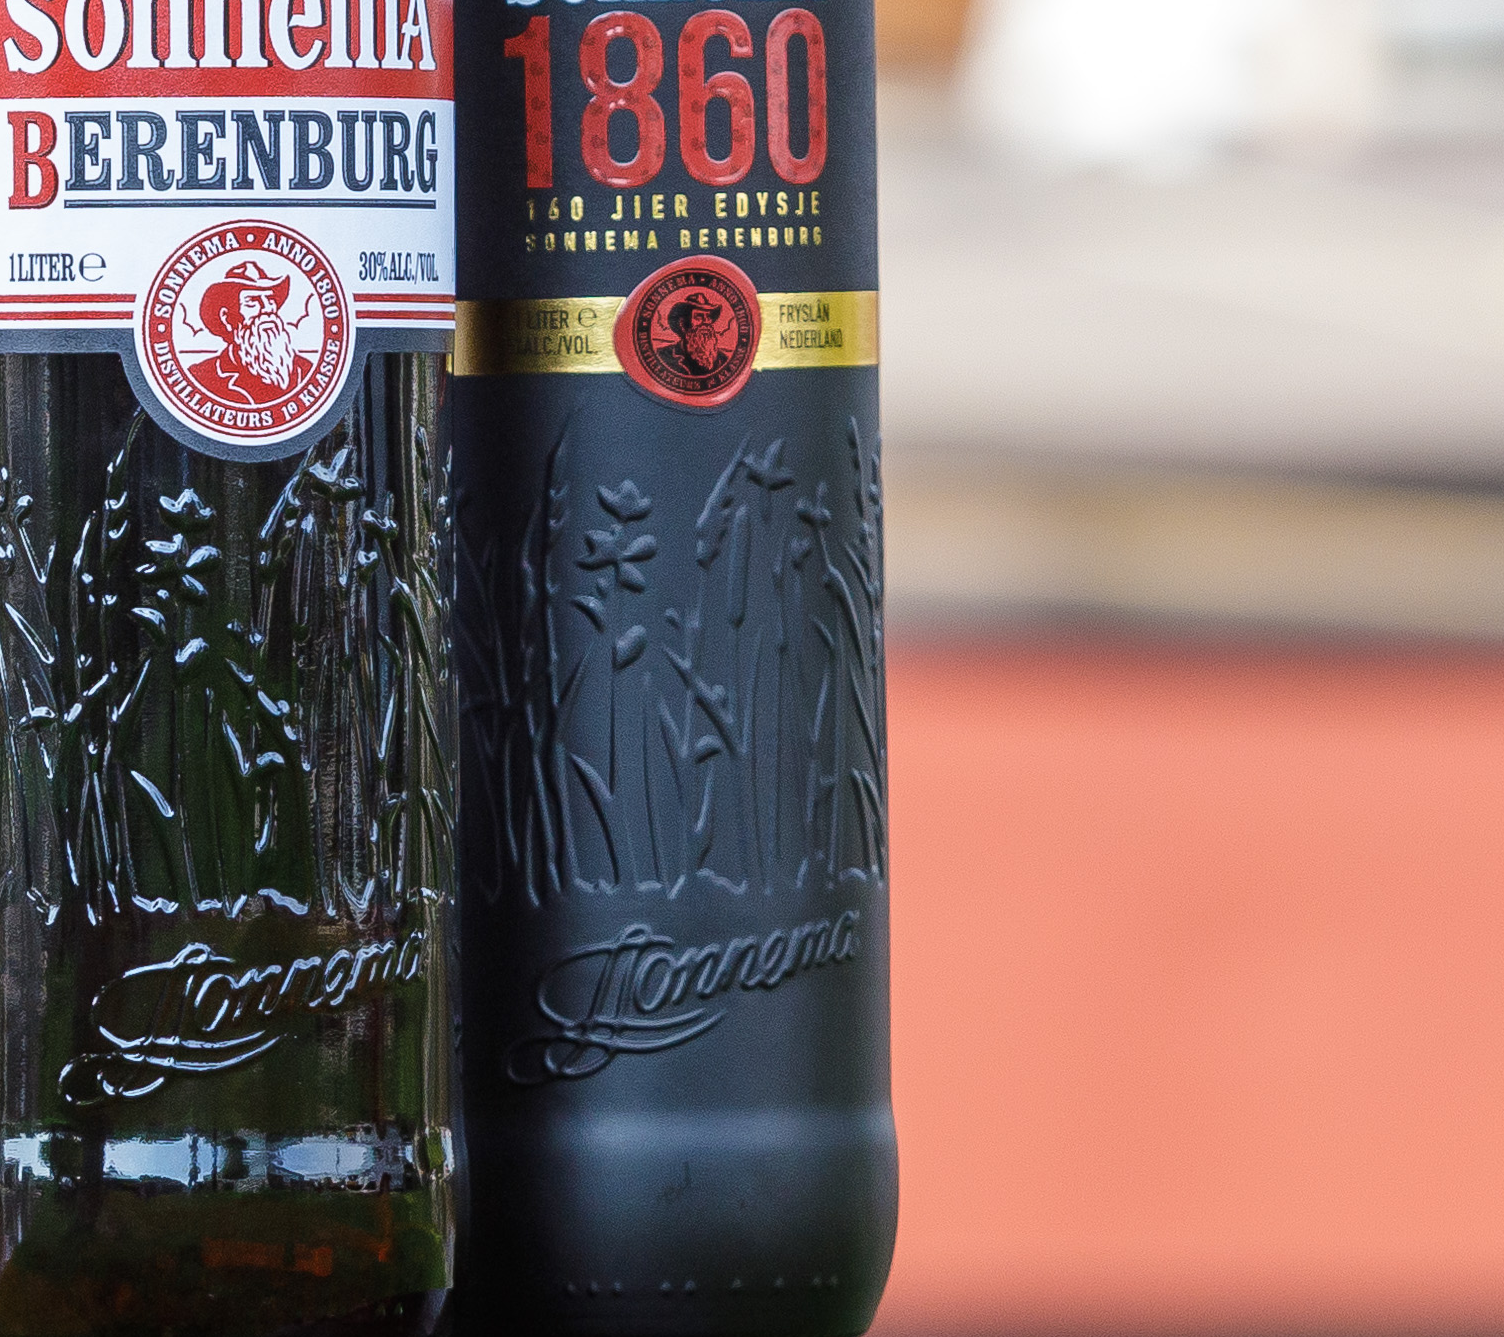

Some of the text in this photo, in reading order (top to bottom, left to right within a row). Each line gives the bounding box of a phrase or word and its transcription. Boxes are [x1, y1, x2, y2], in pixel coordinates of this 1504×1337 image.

[503, 7, 829, 190] 1860
[7, 109, 438, 210] BERENBURG
[525, 226, 823, 253] SONNEMA BERENBURG
[610, 193, 690, 221] JIER
[714, 190, 822, 218] EDYSJE
[153, 231, 341, 320] SONNEMA ANNO 1860
[779, 298, 830, 323] FRYSLÂN
[153, 340, 274, 428] DISTILLATEURS
[298, 338, 341, 407] KLASSE
